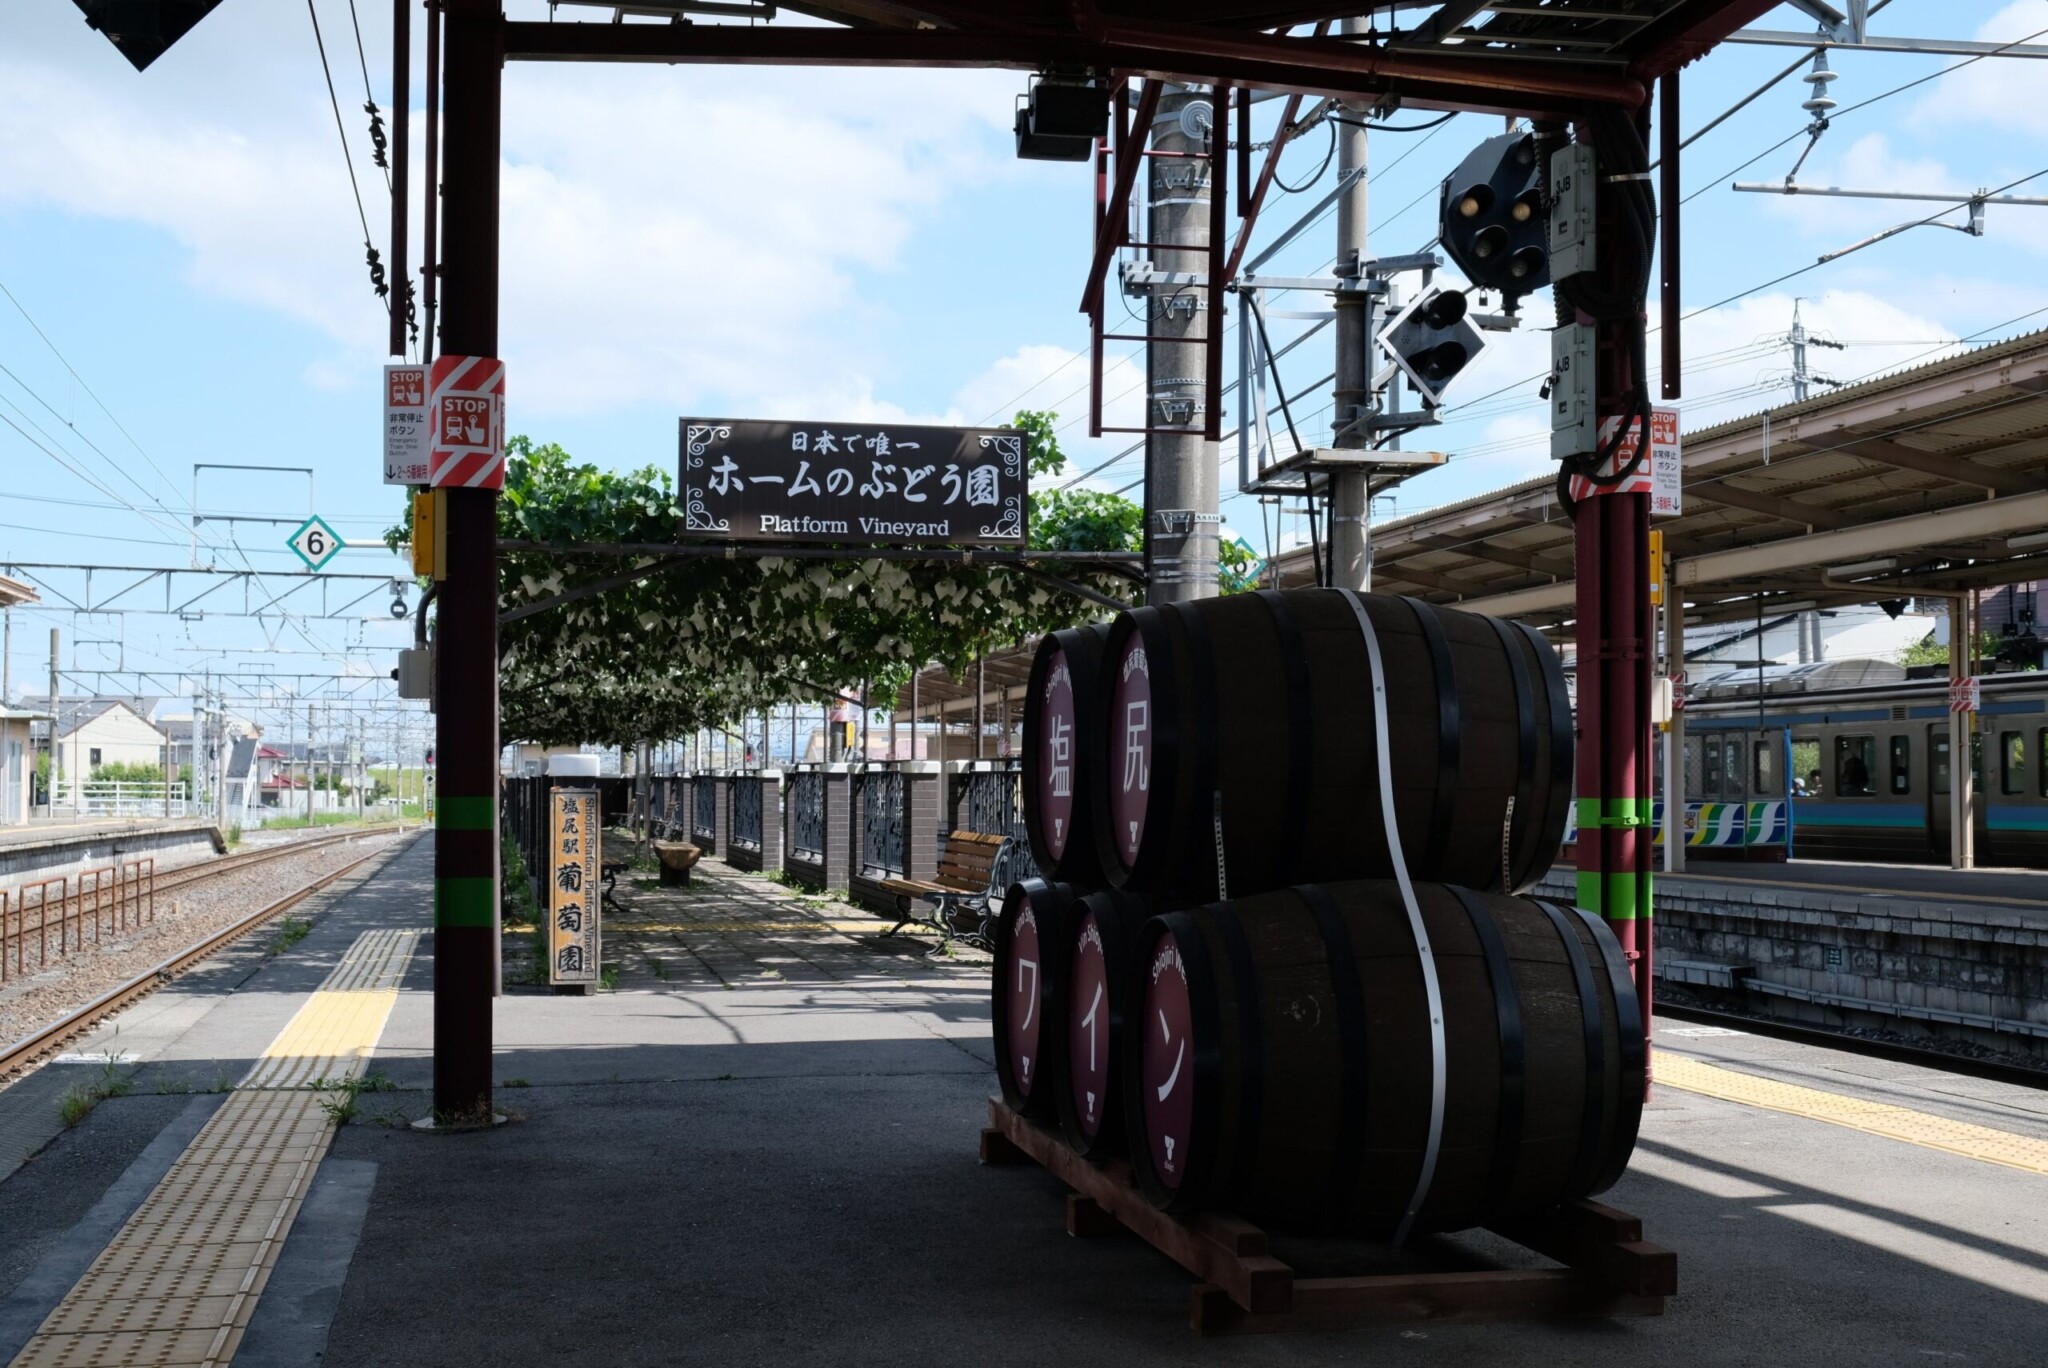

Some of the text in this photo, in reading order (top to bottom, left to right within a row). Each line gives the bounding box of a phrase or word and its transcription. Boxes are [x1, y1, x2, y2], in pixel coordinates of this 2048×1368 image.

[1556, 175, 1571, 195] 3JB
[1555, 355, 1570, 374] 4JB
[392, 373, 422, 382] STOP
[389, 413, 424, 423] 非常停止
[444, 399, 487, 413] STOP
[1652, 413, 1675, 423] STOP
[389, 425, 415, 435] ボタン
[791, 430, 920, 456] 日本で唯一
[1658, 462, 1677, 471] ボタン
[708, 455, 1000, 507] ホームのぶどう園
[760, 515, 950, 537] Platform Vineyard
[307, 530, 324, 555] 6
[1049, 714, 1071, 797] 塩
[1123, 700, 1148, 795] 尻
[585, 880, 594, 926] Platform
[585, 927, 595, 974] Vineyard
[1018, 958, 1037, 1031] ワ
[1082, 980, 1103, 1072] イ
[1157, 1008, 1185, 1102] ン
